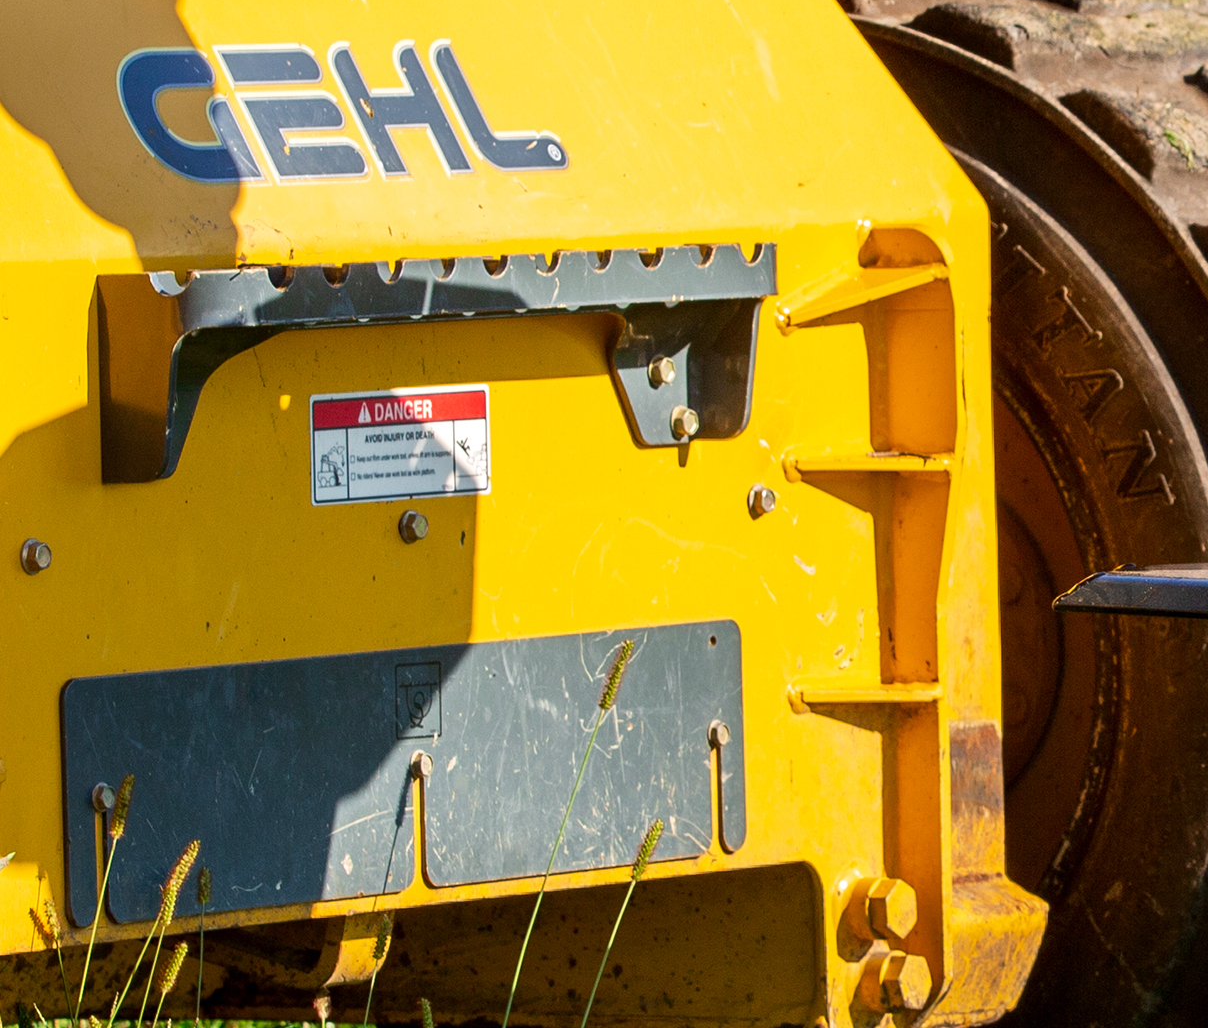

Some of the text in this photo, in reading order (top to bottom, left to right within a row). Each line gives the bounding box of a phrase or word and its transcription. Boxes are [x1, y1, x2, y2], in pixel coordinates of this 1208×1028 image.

[117, 39, 568, 184] GEHL
[991, 220, 1175, 505] ITAN
[365, 430, 435, 444] AVOID INJURY OR DEATH
[374, 399, 432, 421] DANGER
